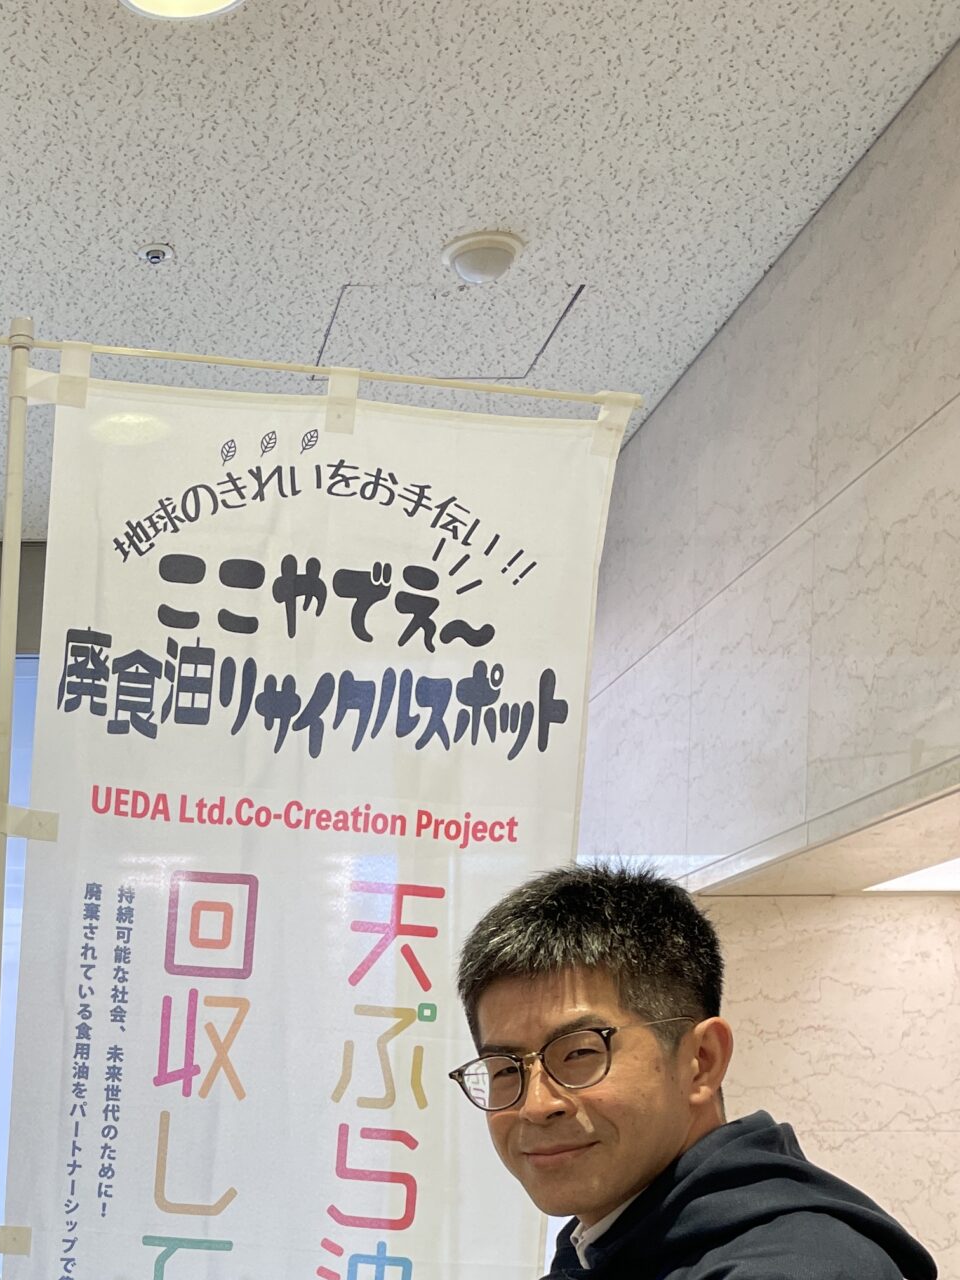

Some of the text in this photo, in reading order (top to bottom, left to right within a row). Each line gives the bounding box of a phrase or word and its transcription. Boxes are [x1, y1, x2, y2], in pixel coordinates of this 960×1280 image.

[56, 625, 569, 761] 廃食油リサイクルスポット
[90, 784, 171, 821] UEDA
[414, 809, 519, 849] Project
